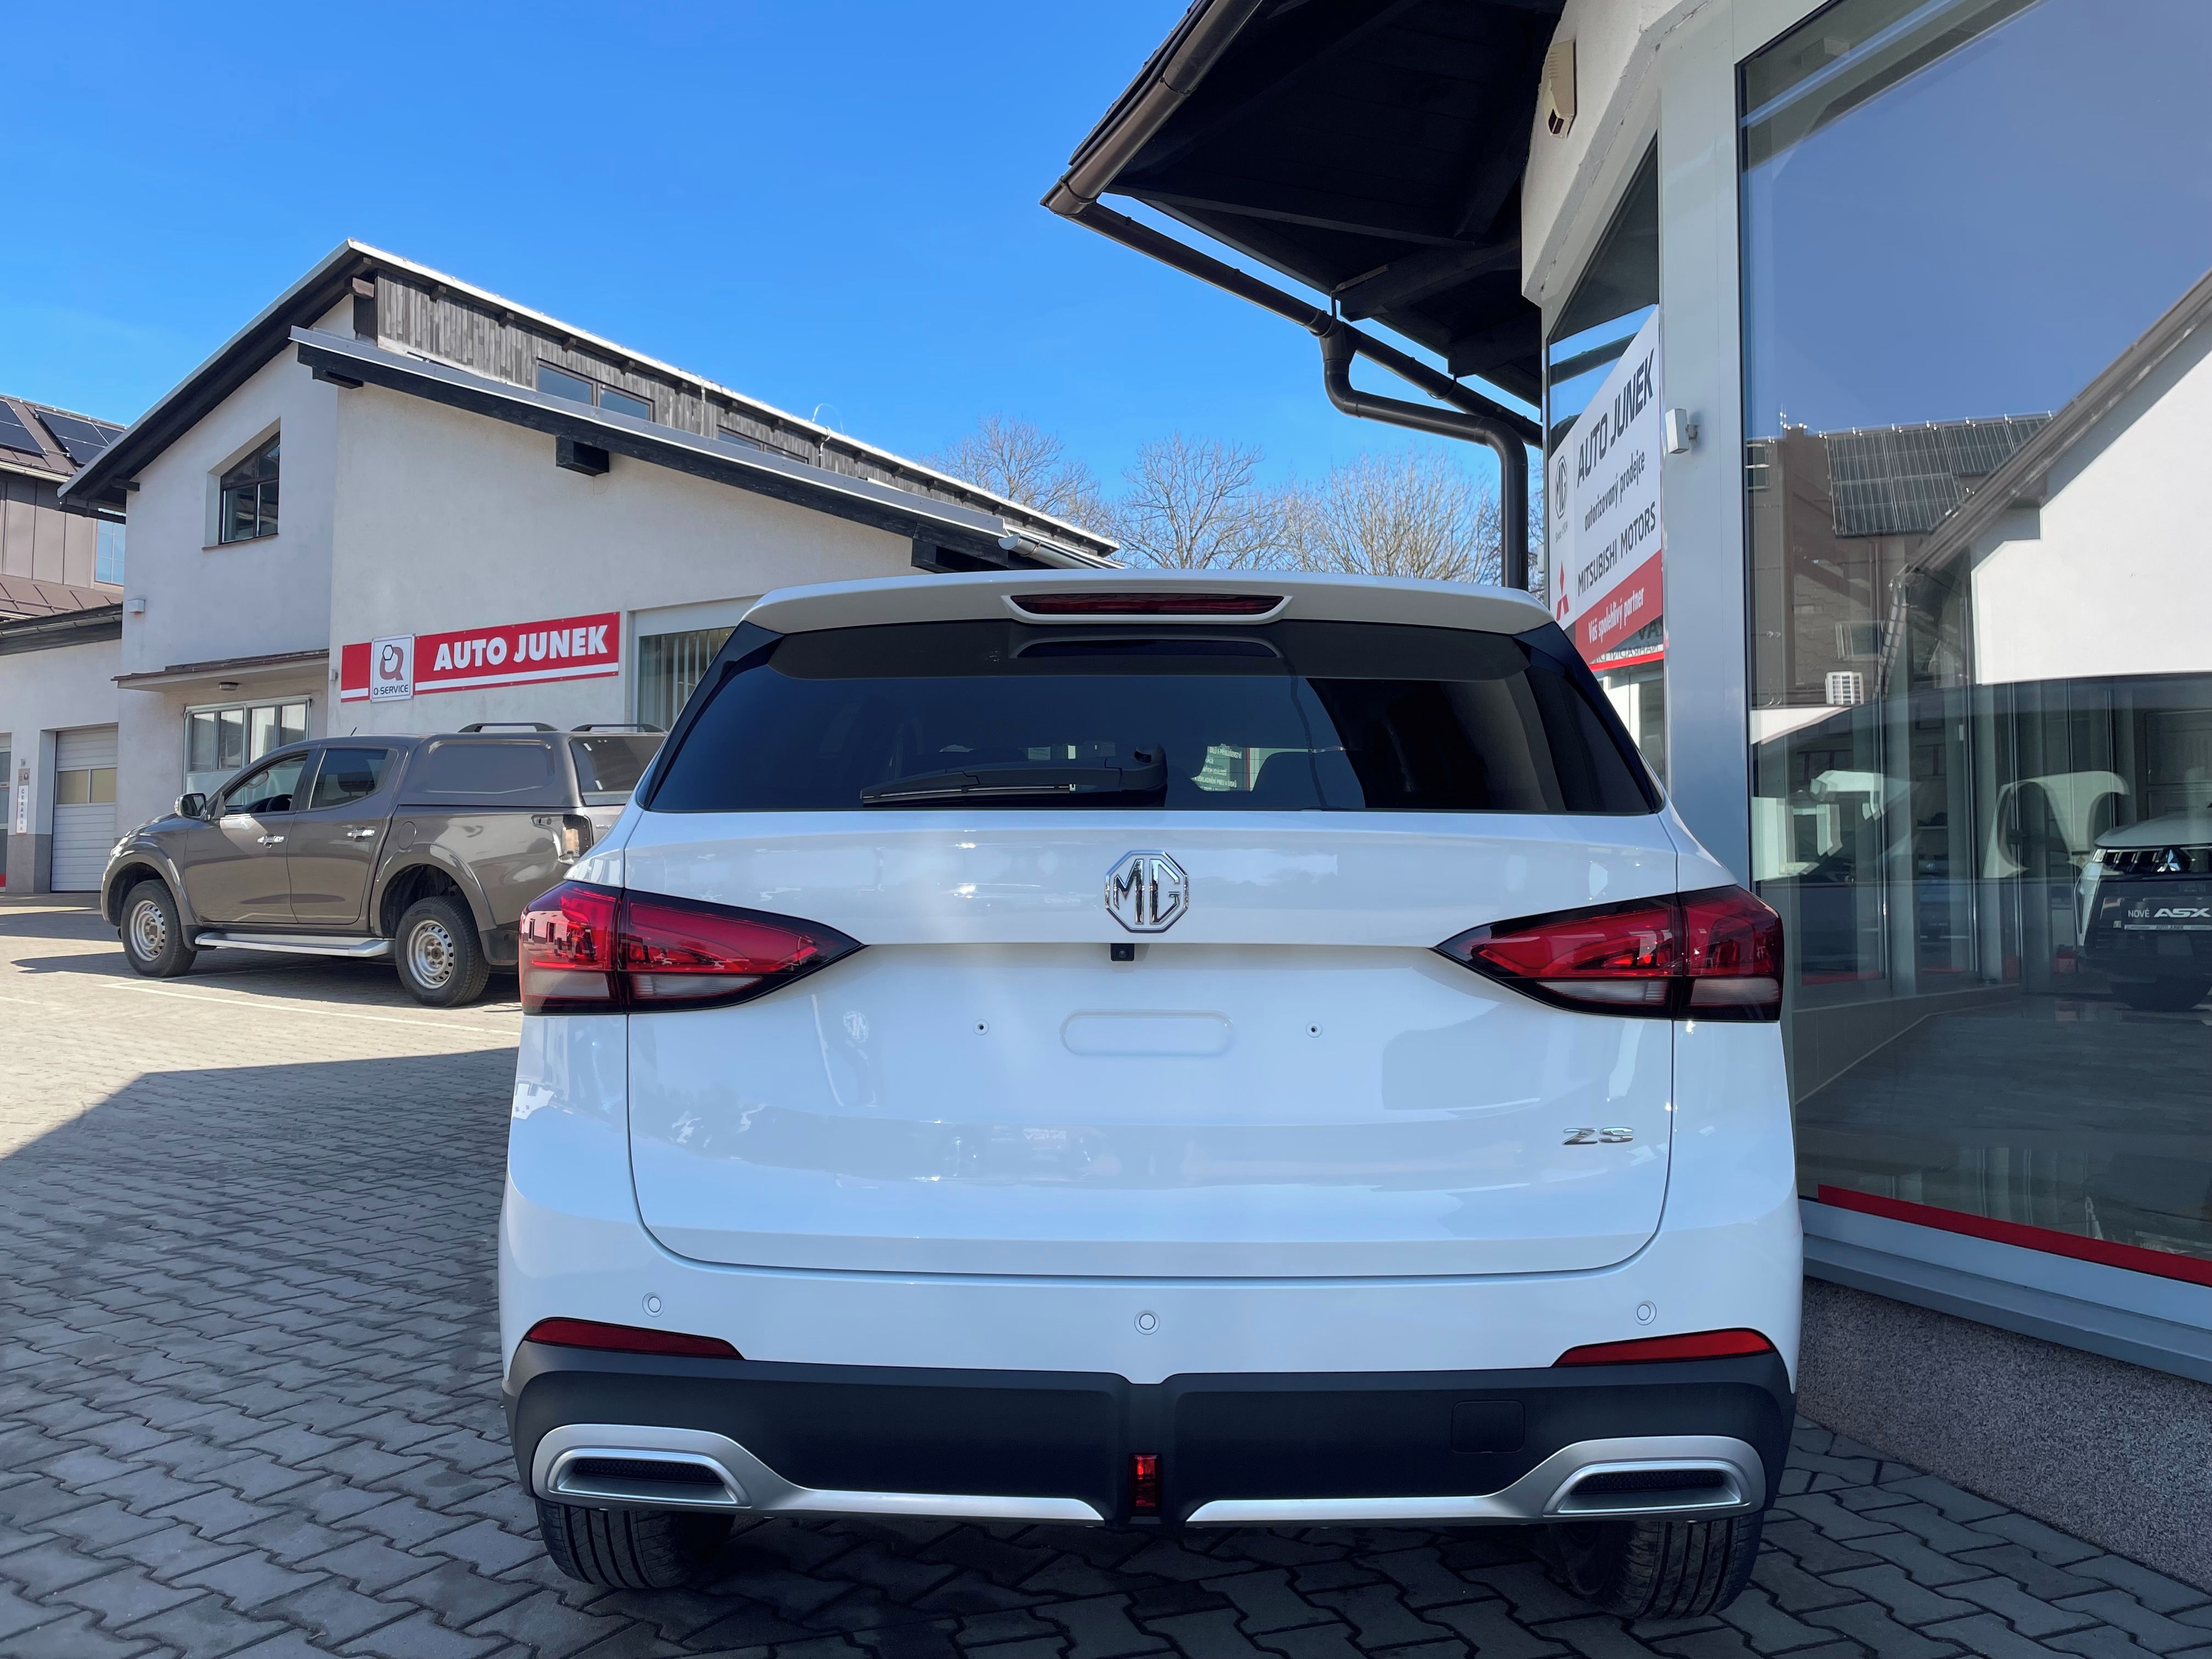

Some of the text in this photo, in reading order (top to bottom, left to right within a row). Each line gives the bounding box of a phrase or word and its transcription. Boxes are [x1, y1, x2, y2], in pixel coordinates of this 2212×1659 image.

[1577, 347, 1655, 489] AUTO JUNEK
[1556, 462, 1566, 513] MG
[1584, 449, 1645, 533] autorizovaný prodejce
[1578, 500, 1656, 597] MITSUBISHI MOTORS
[1588, 617, 1598, 645] Váš
[1598, 597, 1623, 644] spolehlivý
[1623, 586, 1644, 627] partner
[433, 624, 608, 672] AUTO JUNEK
[1113, 858, 1180, 925] MG
[2128, 907, 2211, 918] NOVÉ ASX
[1562, 1127, 1634, 1146] ZS
